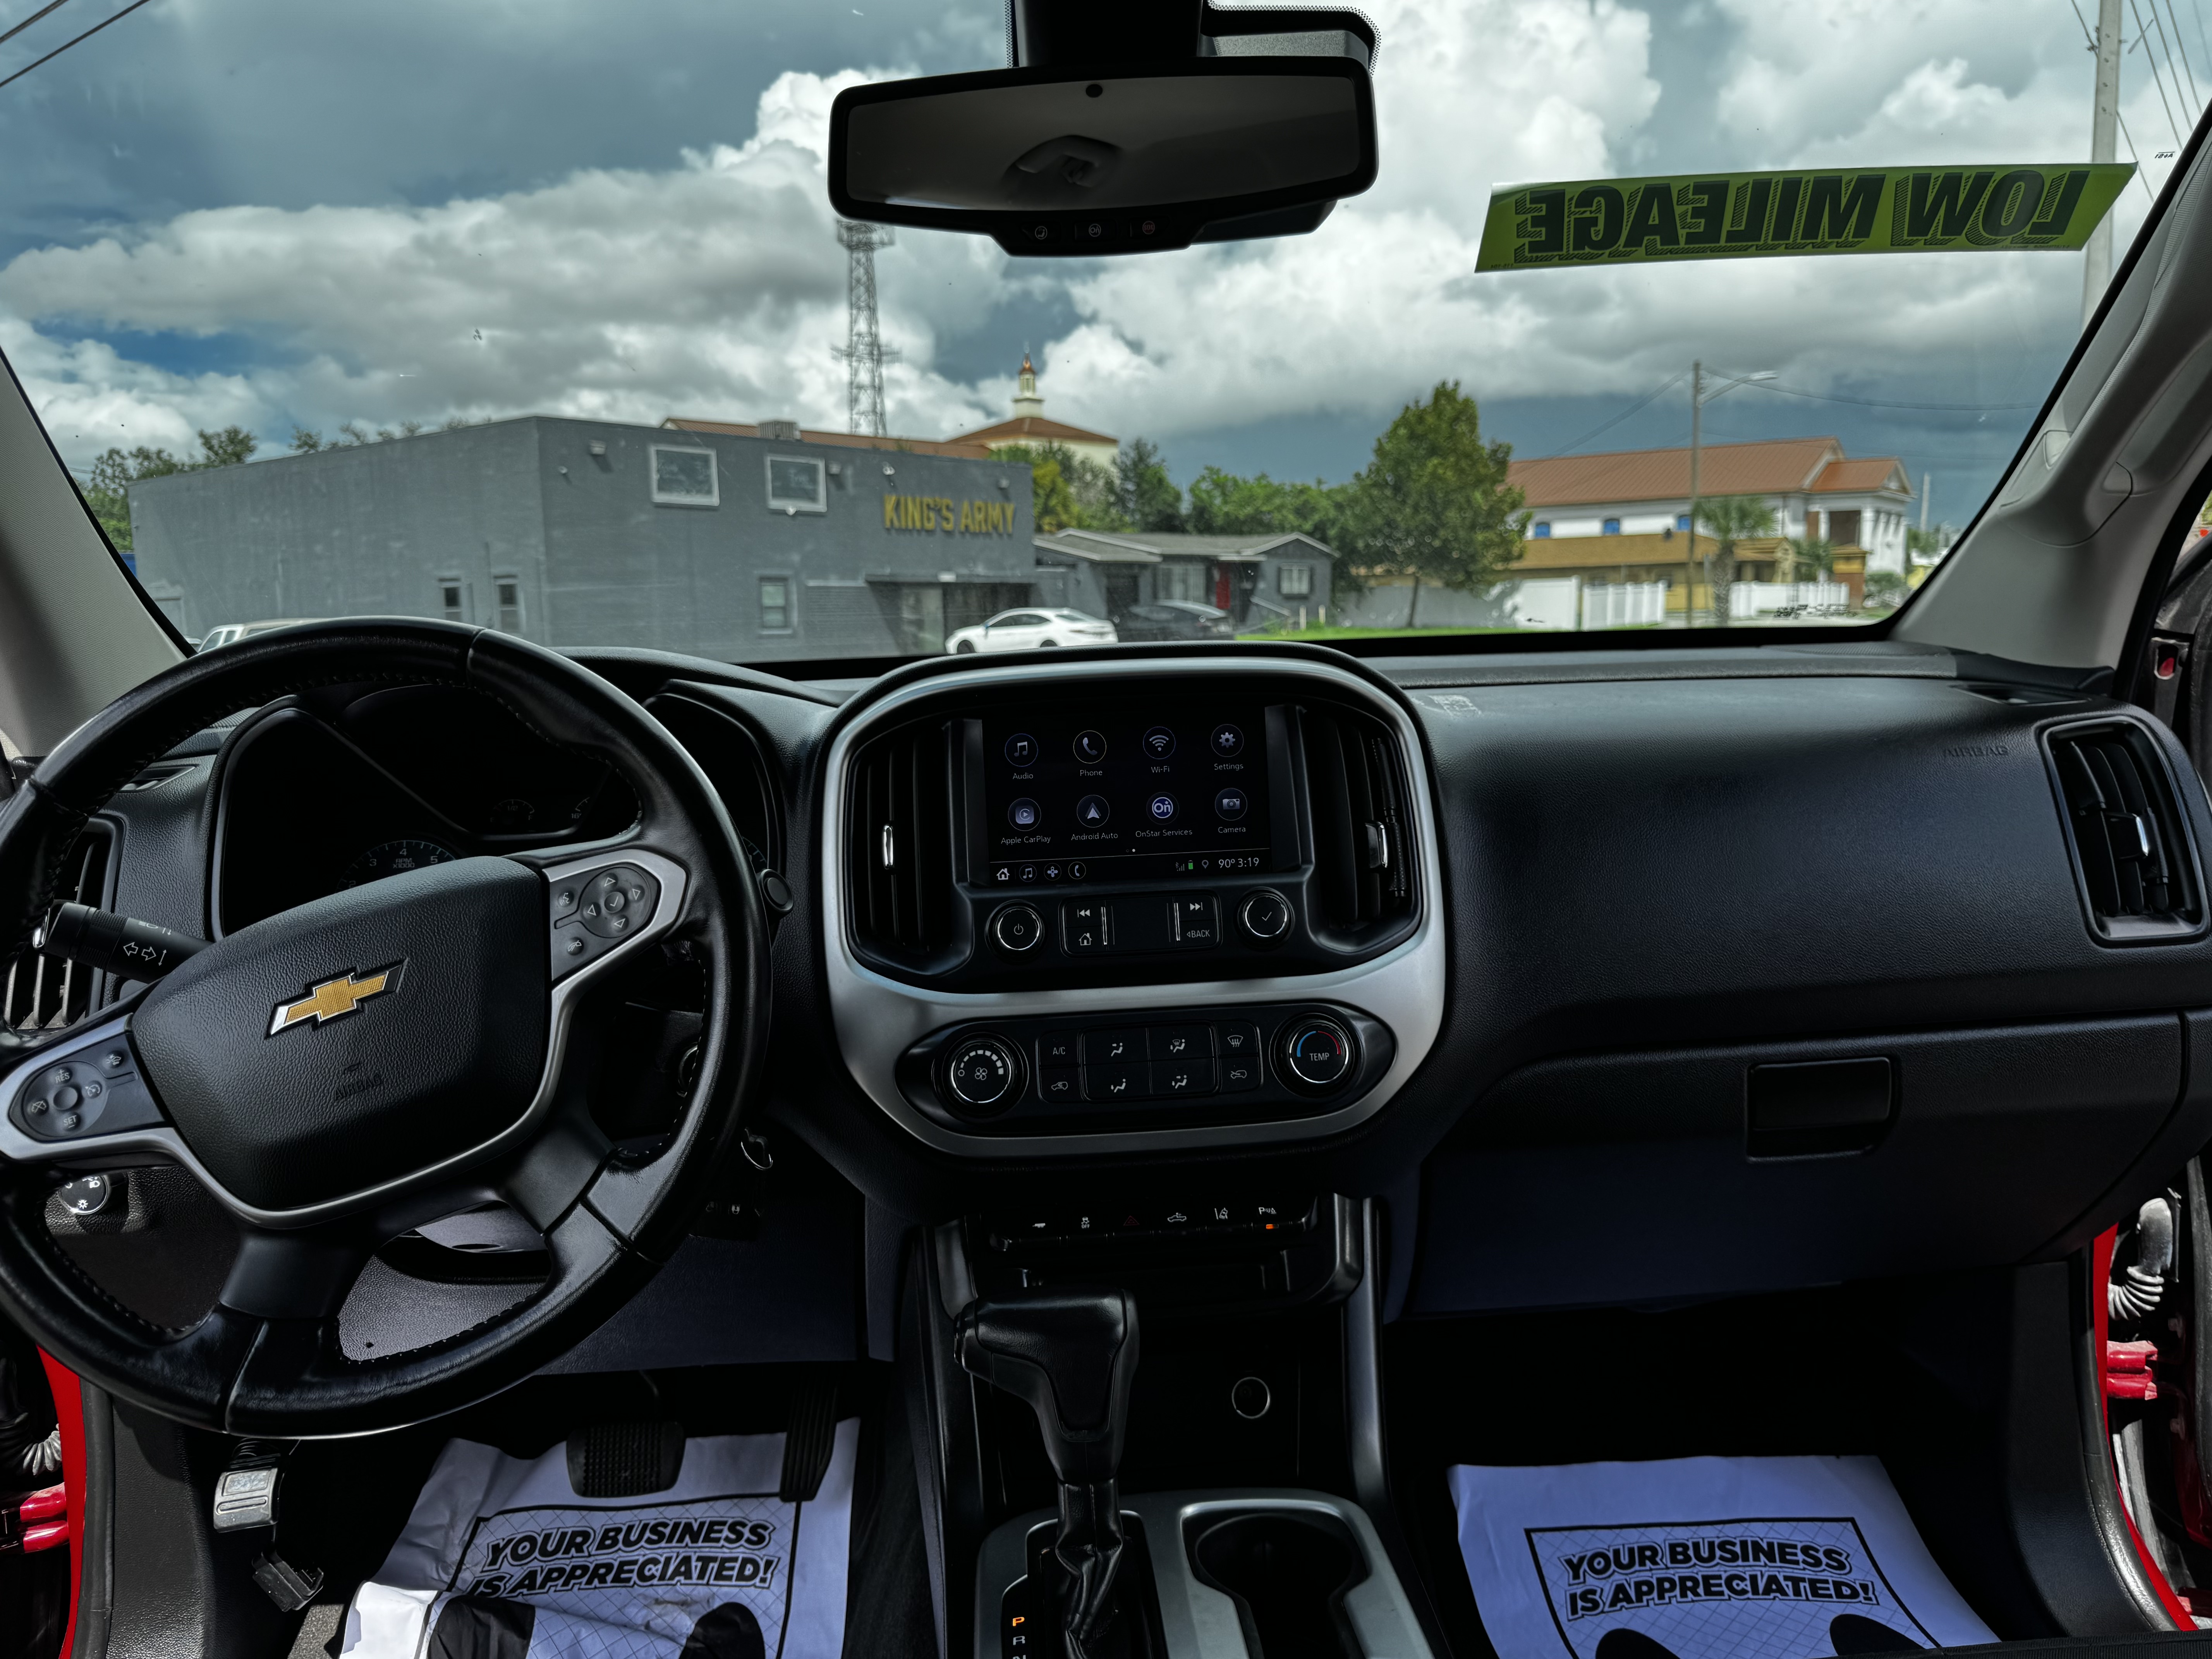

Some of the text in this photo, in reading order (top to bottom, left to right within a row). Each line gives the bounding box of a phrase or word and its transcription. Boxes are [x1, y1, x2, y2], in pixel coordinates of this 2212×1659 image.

[884, 495, 1015, 534] KING'S ARMY
[1944, 745, 2009, 758] AIRBAG
[1214, 763, 1243, 771] Settings
[1024, 836, 1051, 844] CarPlay
[1238, 857, 1259, 867] 3:19
[1191, 929, 1210, 939] BACK
[1053, 1047, 1065, 1055] A/C
[1309, 1051, 1330, 1062] TEMP
[55, 1072, 70, 1082] RES
[335, 1074, 381, 1100] AIRBAG
[63, 1116, 77, 1126] SET
[485, 1518, 775, 1571] YOUR BUSINESS
[1563, 1538, 1852, 1584] YOUR BUSINESS
[467, 1553, 779, 1599] IS APPRECIATED!
[1567, 1571, 1877, 1619] IS APPRECIATED!
[1012, 1616, 1025, 1626] P
[1013, 1635, 1025, 1645] R
